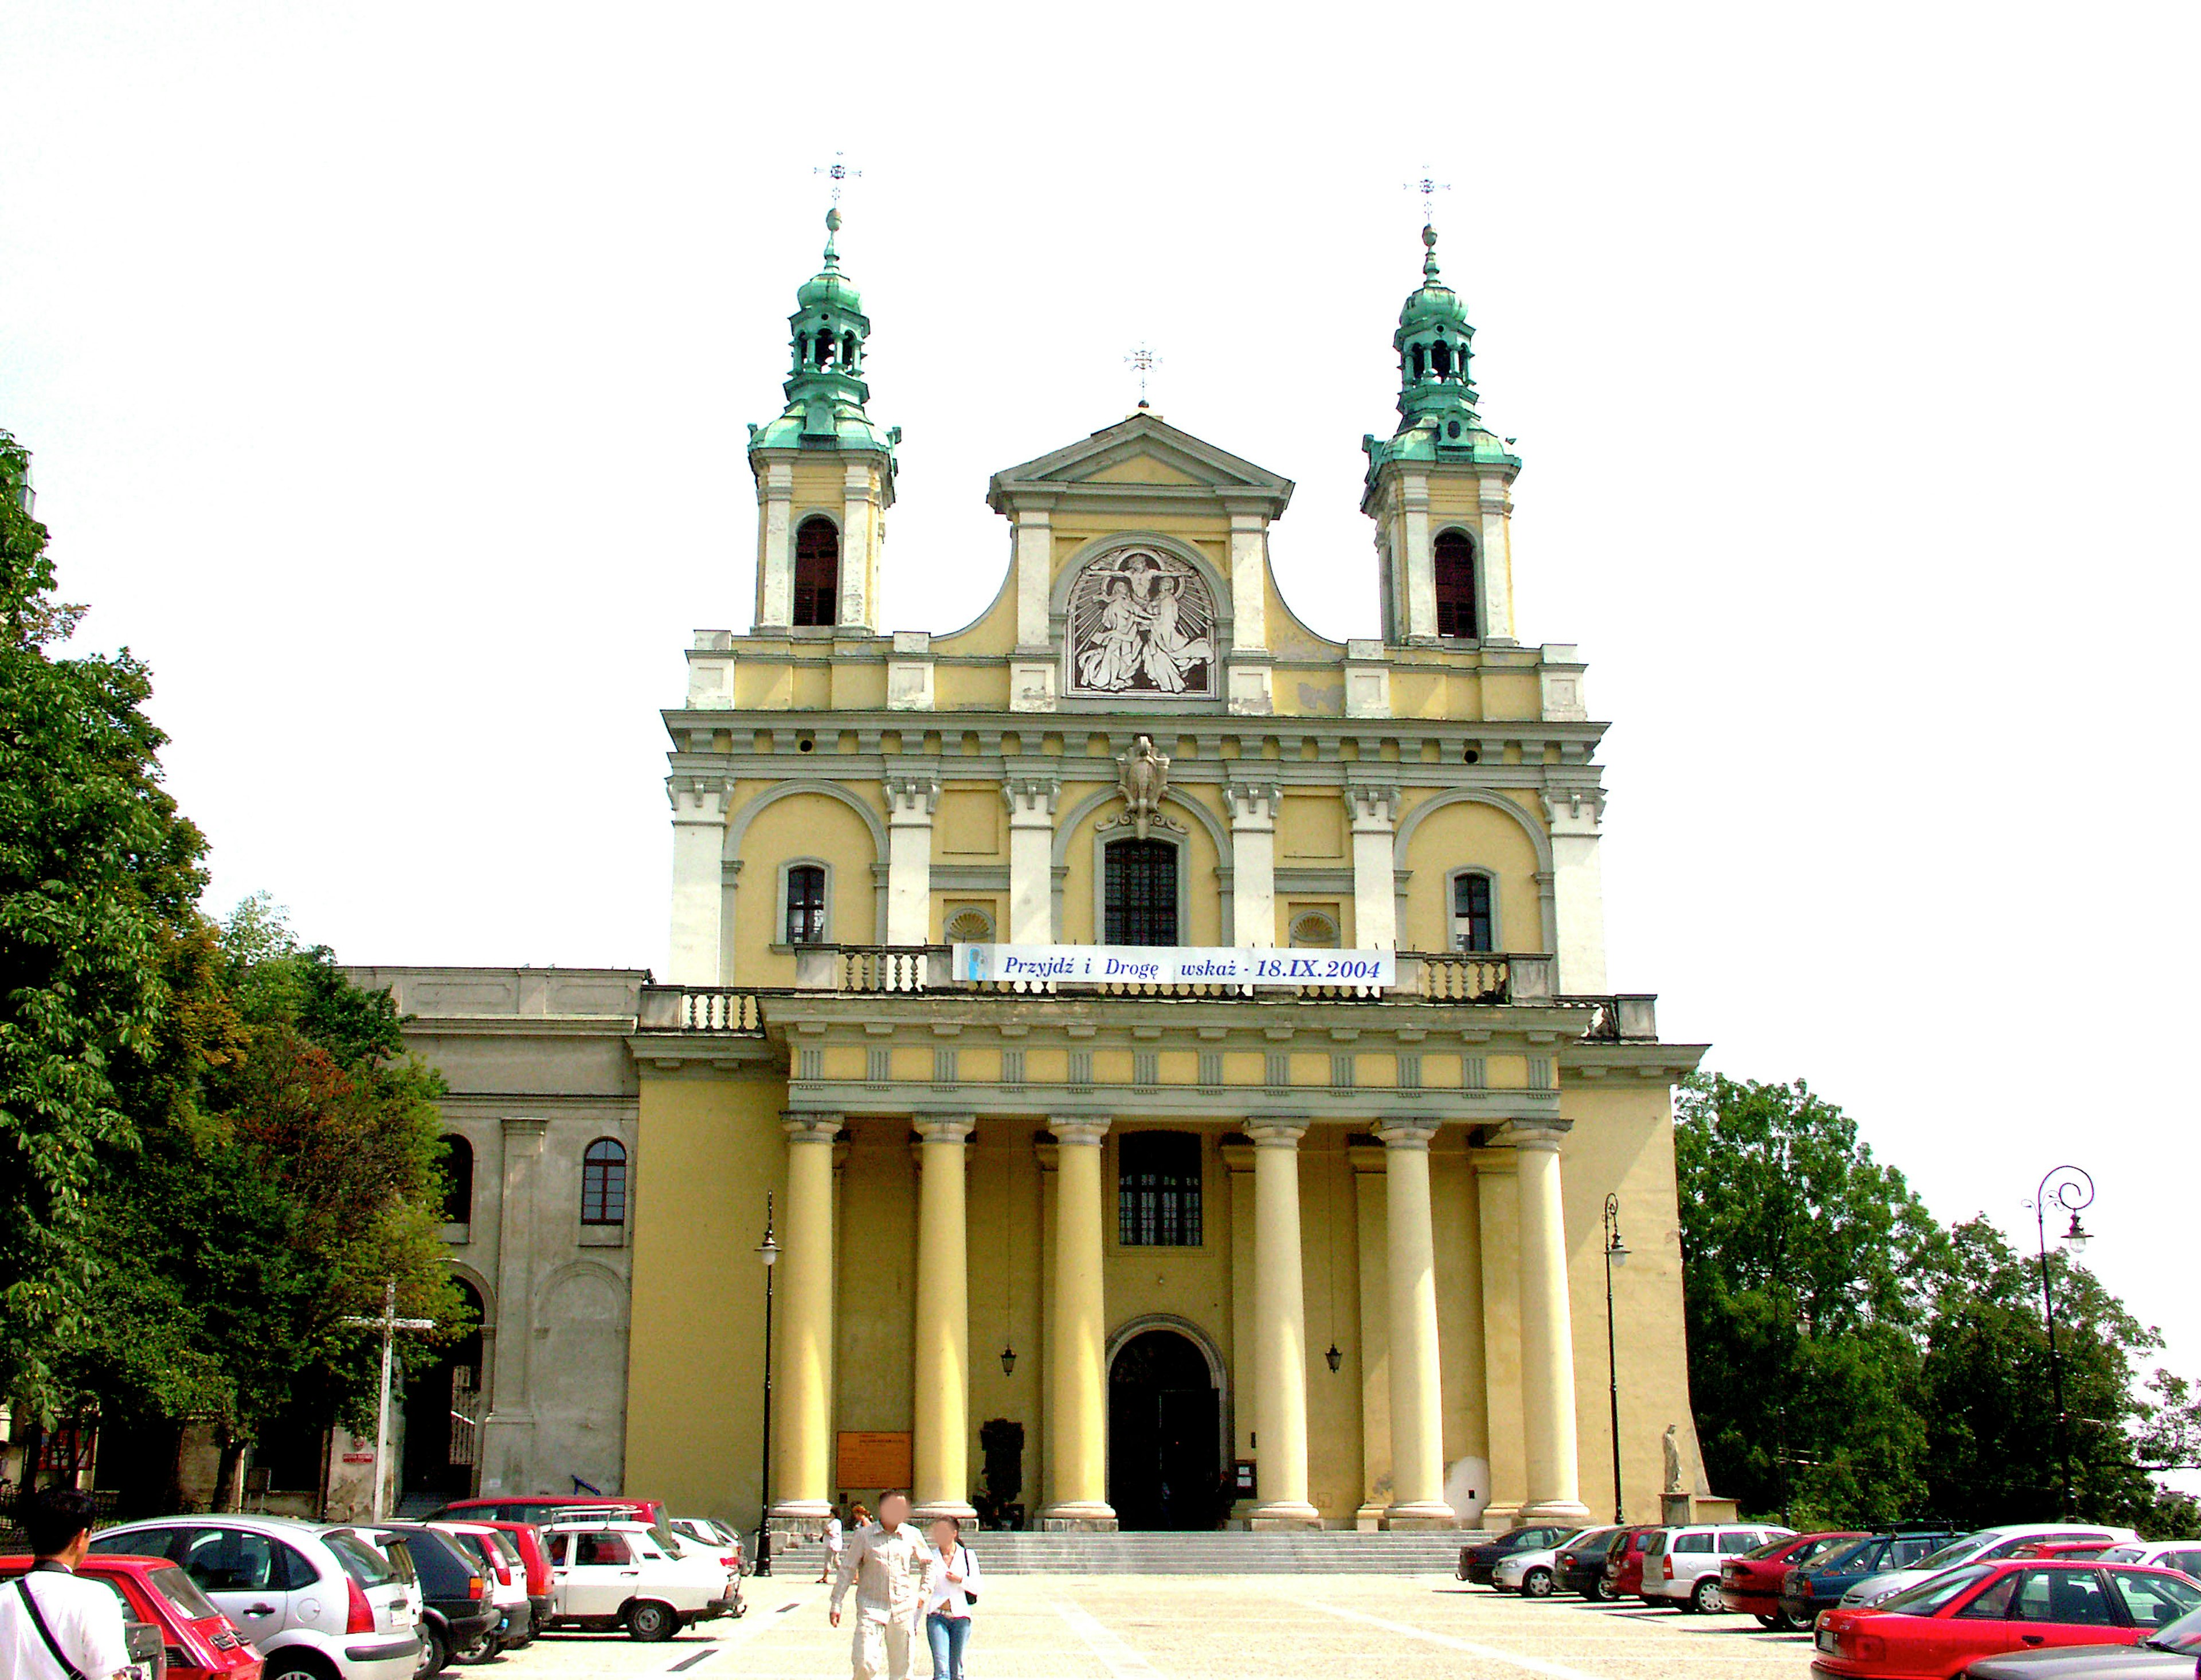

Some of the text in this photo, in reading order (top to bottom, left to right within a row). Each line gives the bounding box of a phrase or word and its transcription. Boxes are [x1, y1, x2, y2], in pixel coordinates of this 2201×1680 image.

[1004, 957, 1074, 978] Przyjdź
[1084, 958, 1091, 974] i
[1105, 958, 1159, 980] Drogę
[1181, 960, 1236, 976] wskaż
[1255, 960, 1380, 978] 18.IX.2004
